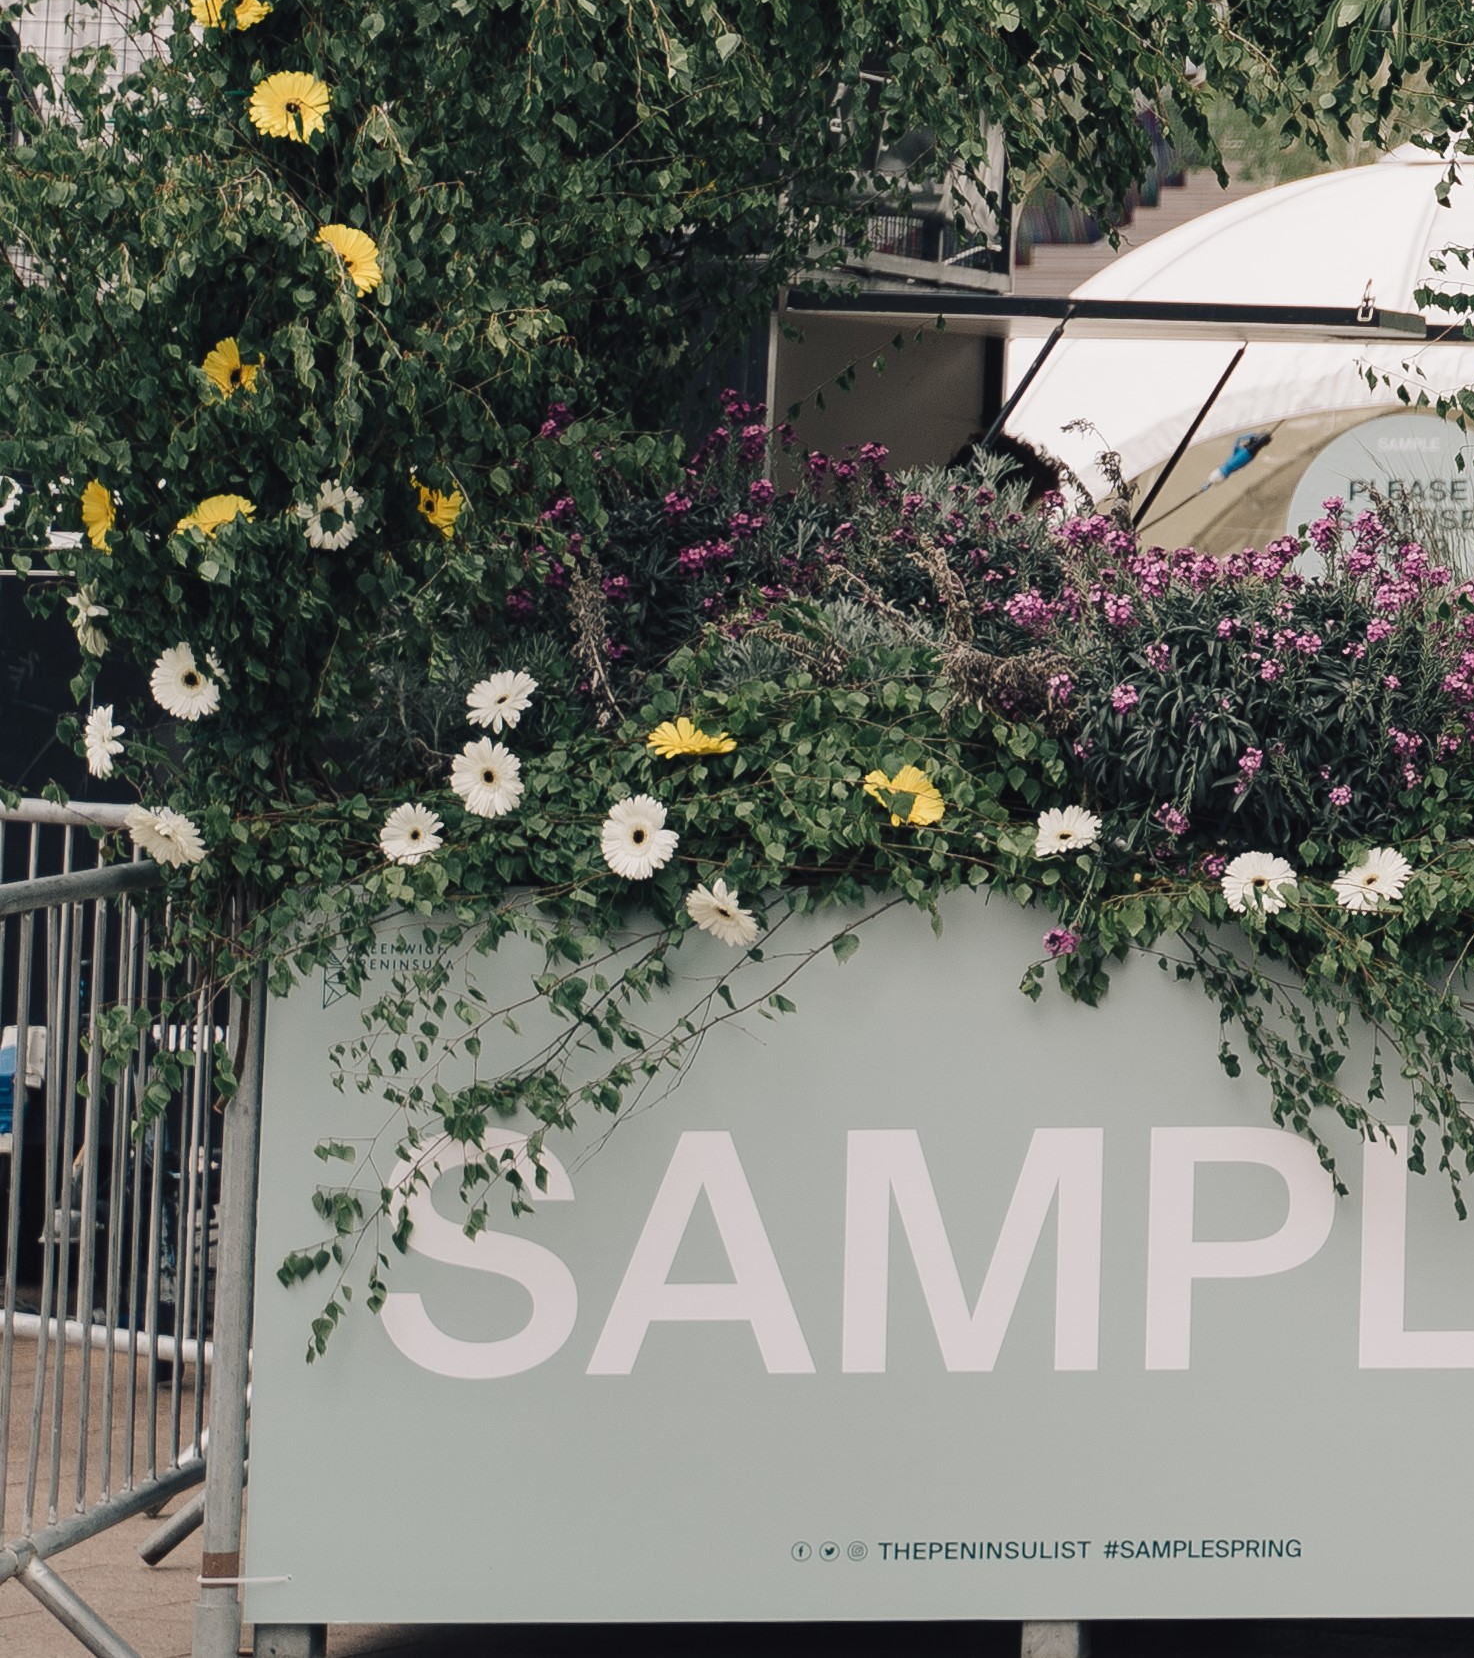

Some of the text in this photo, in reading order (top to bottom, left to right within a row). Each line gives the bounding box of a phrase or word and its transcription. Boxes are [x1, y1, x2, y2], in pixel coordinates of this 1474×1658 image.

[1376, 436, 1442, 453] SAMPLE
[878, 1539, 1303, 1561] THEPENINSULIST #SAMPLESPRING
